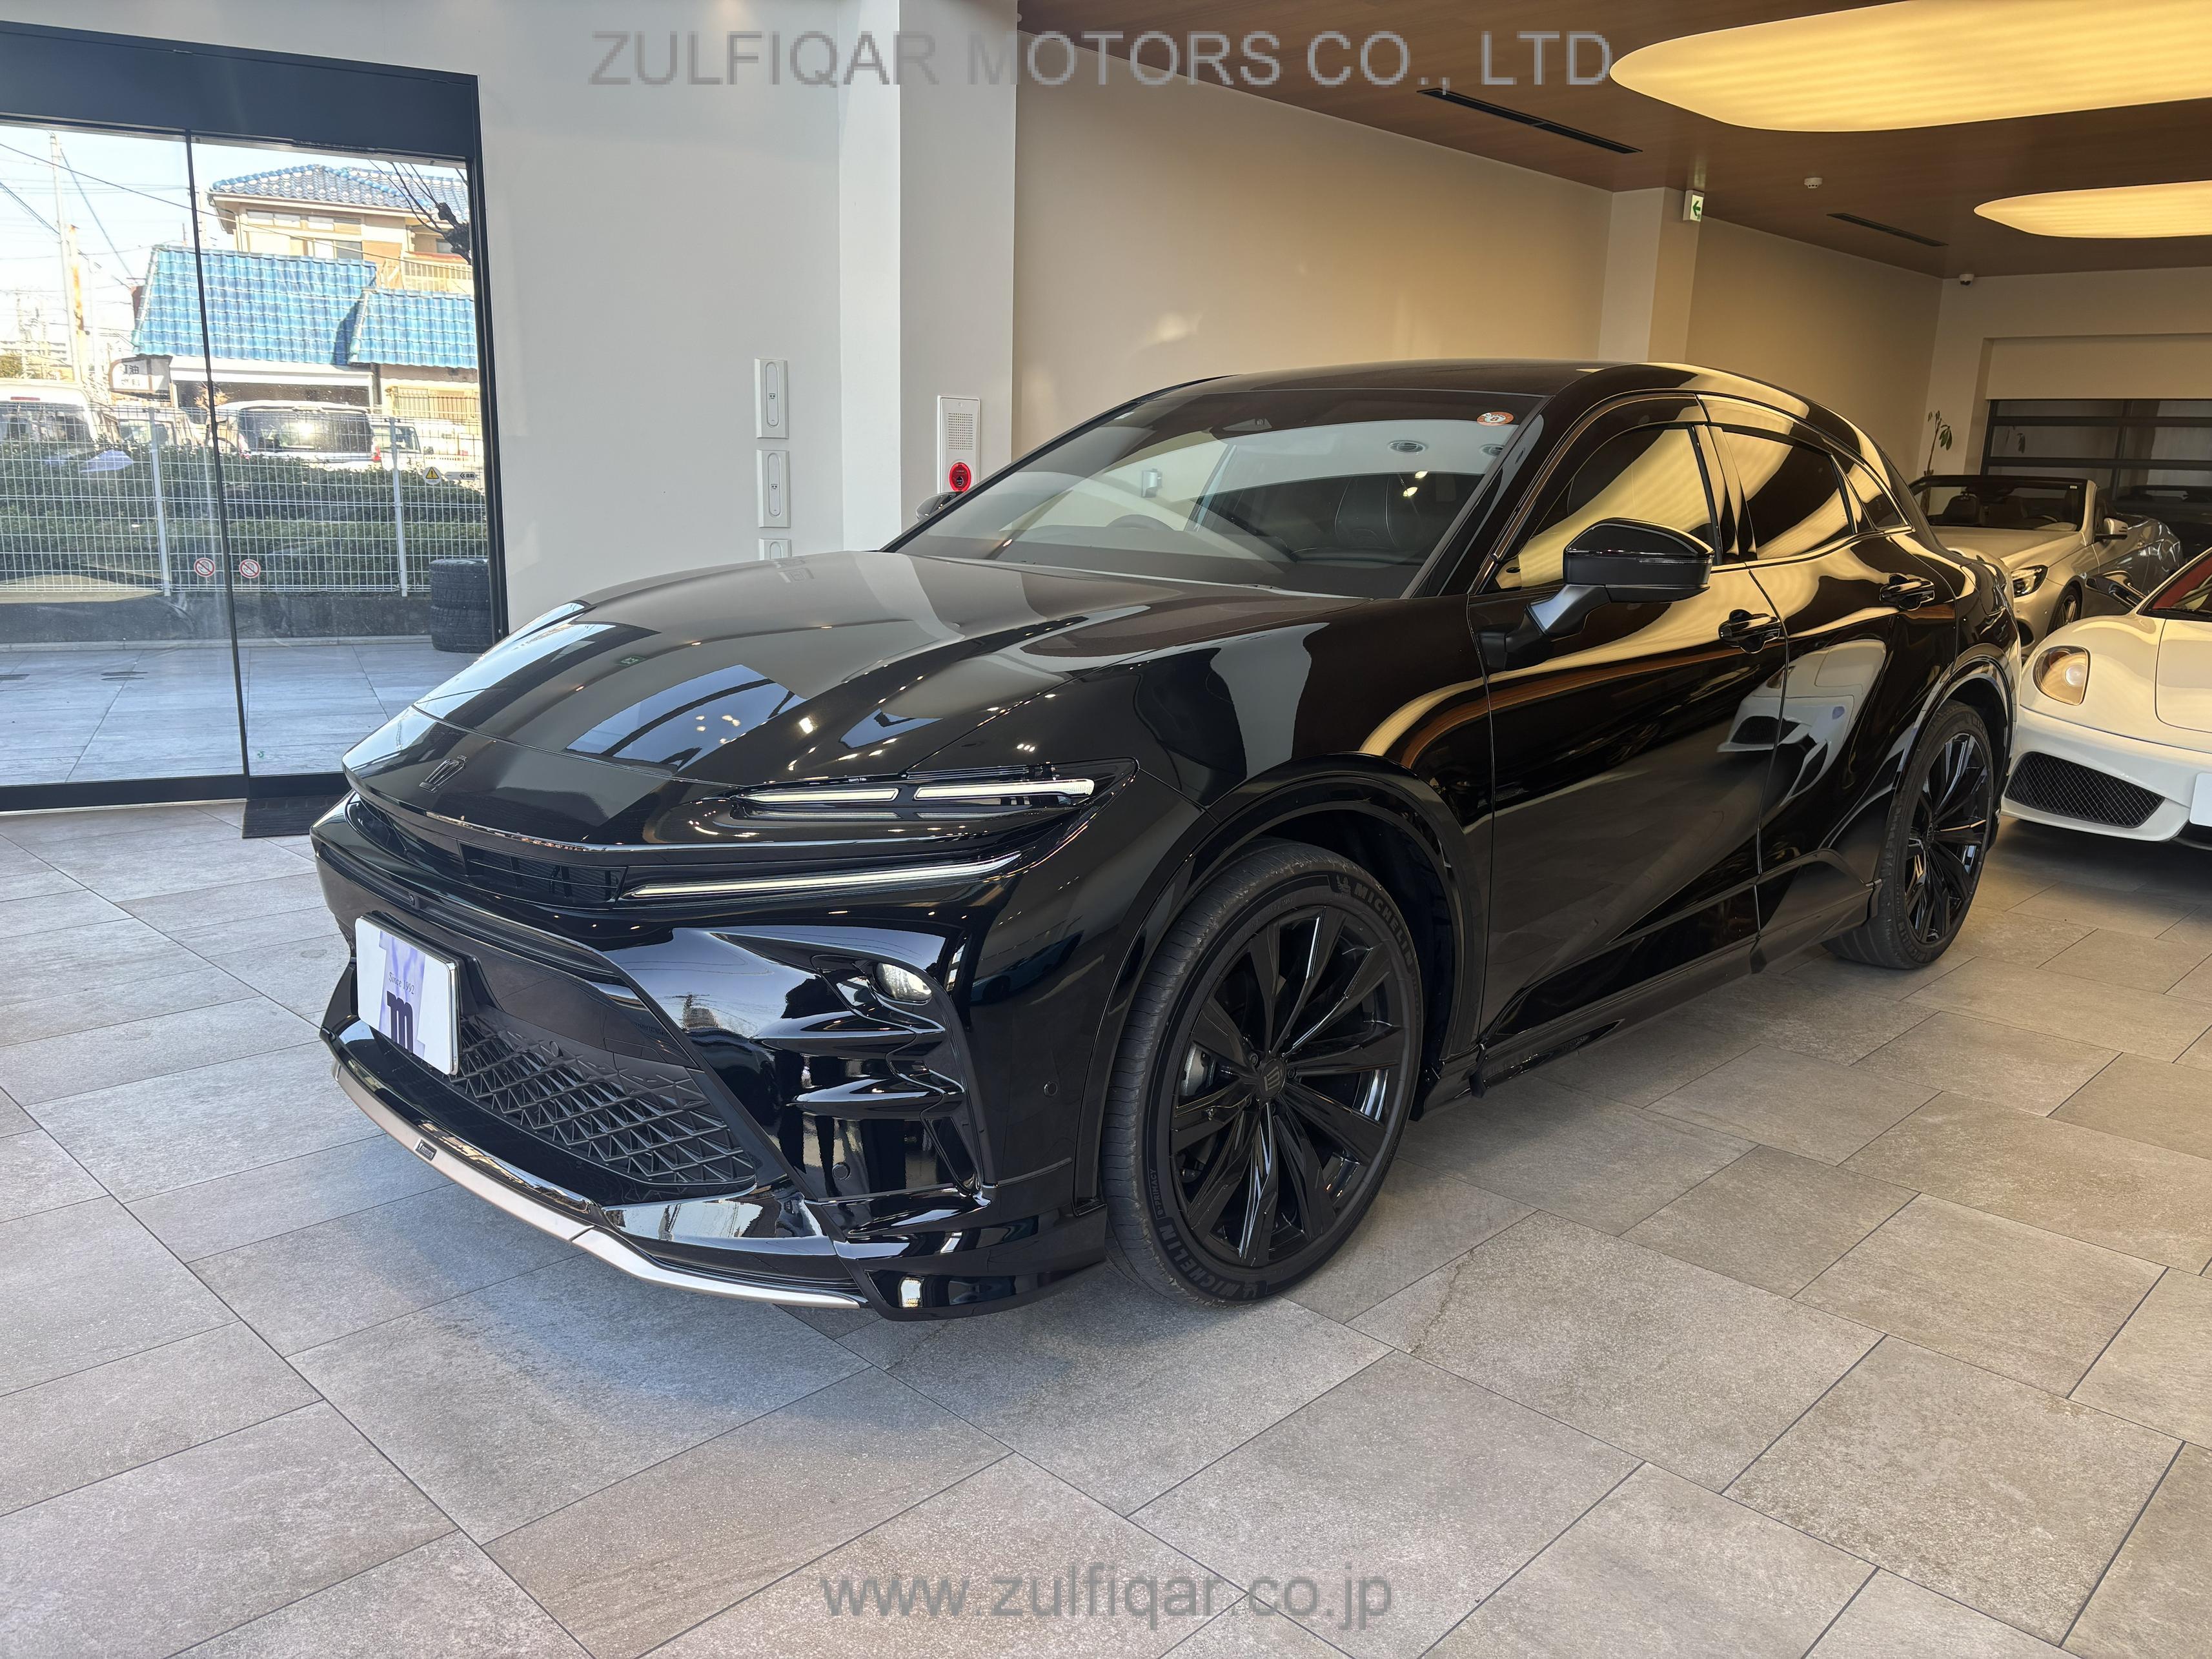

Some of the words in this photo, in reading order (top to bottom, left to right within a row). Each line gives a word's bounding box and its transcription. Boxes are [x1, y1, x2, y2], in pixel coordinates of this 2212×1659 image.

[1354, 882, 1414, 967] MICHELIN
[389, 972, 402, 988] Since
[403, 982, 415, 995] 1992
[1159, 1224, 1241, 1297] MICHELIN
